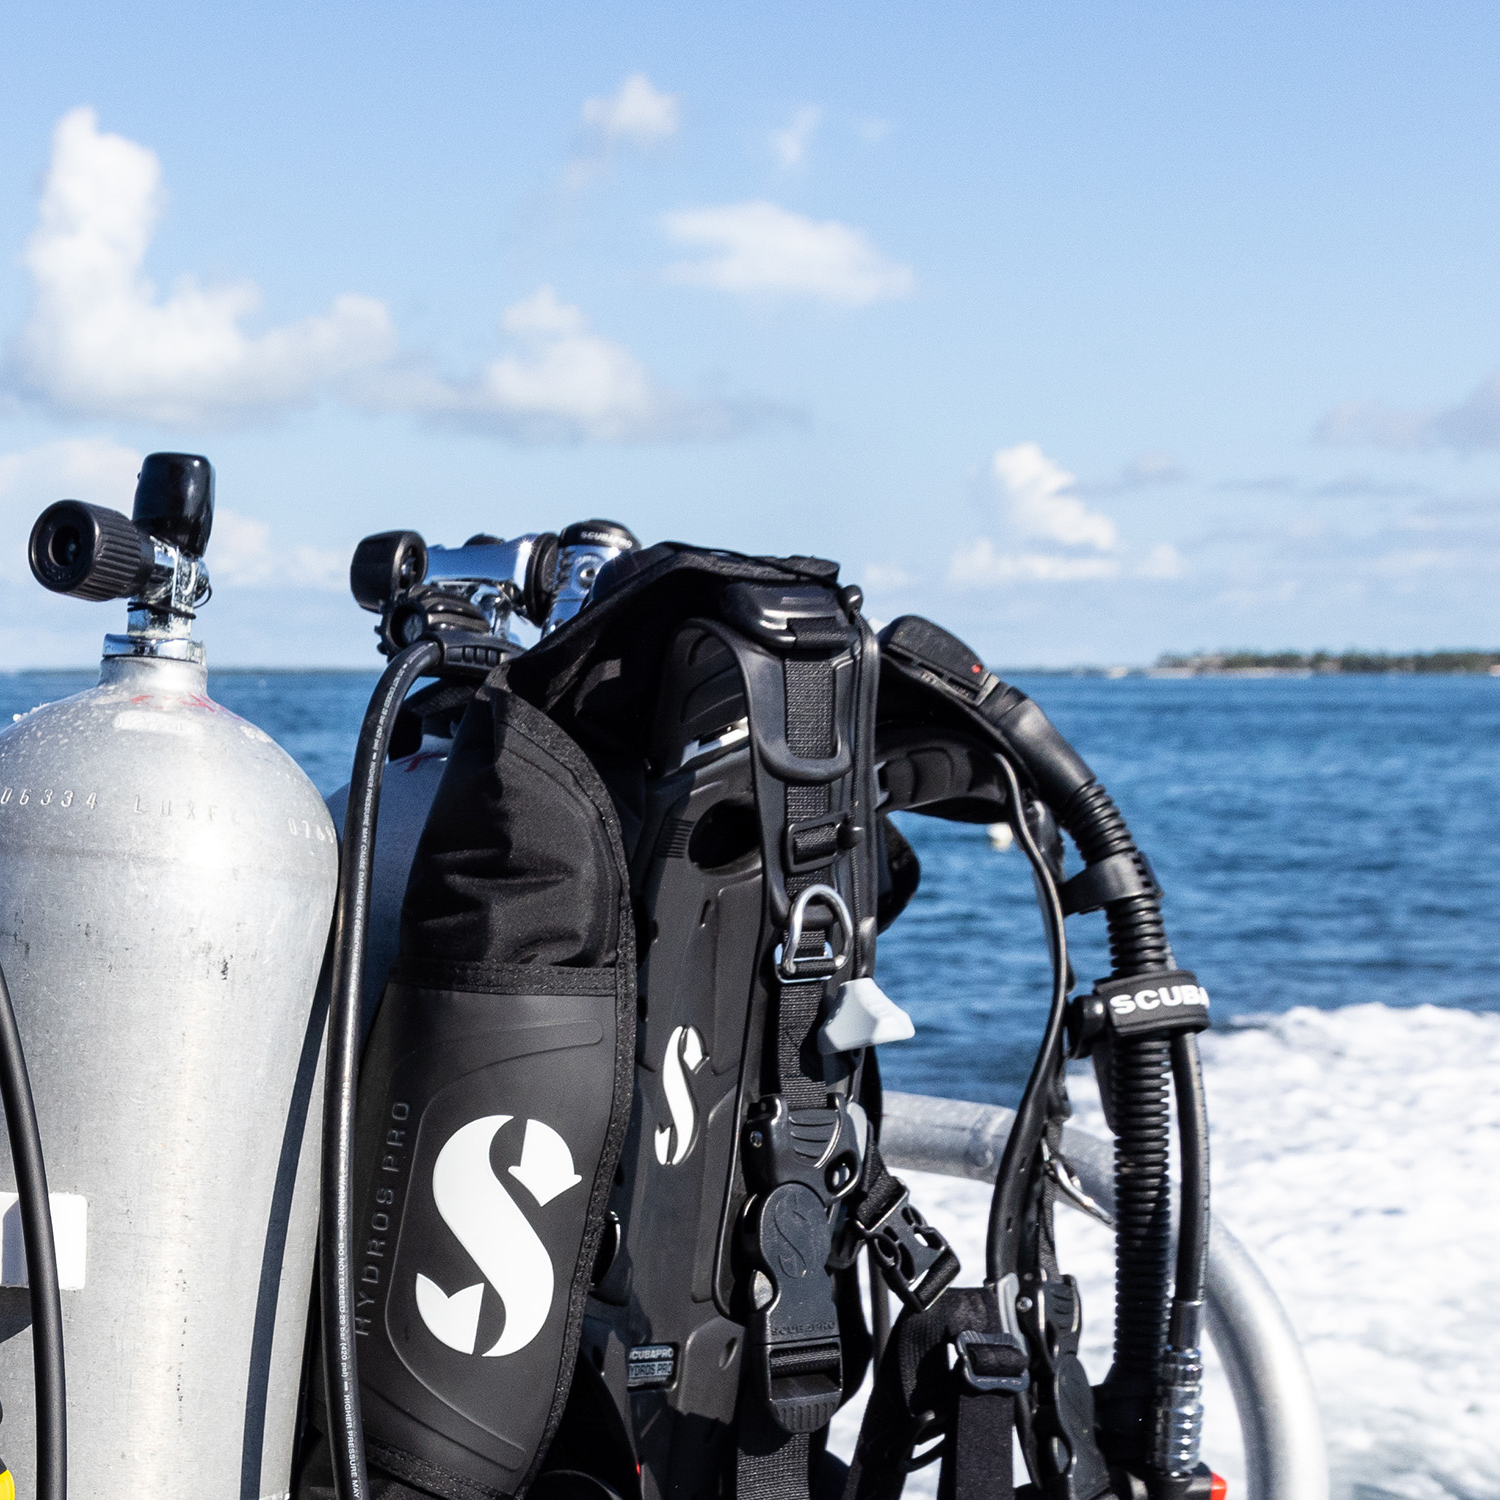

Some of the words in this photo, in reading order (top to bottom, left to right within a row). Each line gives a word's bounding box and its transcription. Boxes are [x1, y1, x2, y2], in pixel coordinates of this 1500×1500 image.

[362, 789, 374, 827] PRESSURE
[381, 1101, 410, 1173] PRO
[337, 1175, 348, 1225] WARNING
[338, 1277, 347, 1313] EXCEED
[343, 1394, 353, 1429] HIGHER
[346, 1431, 358, 1477] PRESSURE
[351, 1480, 360, 1498] MAY
